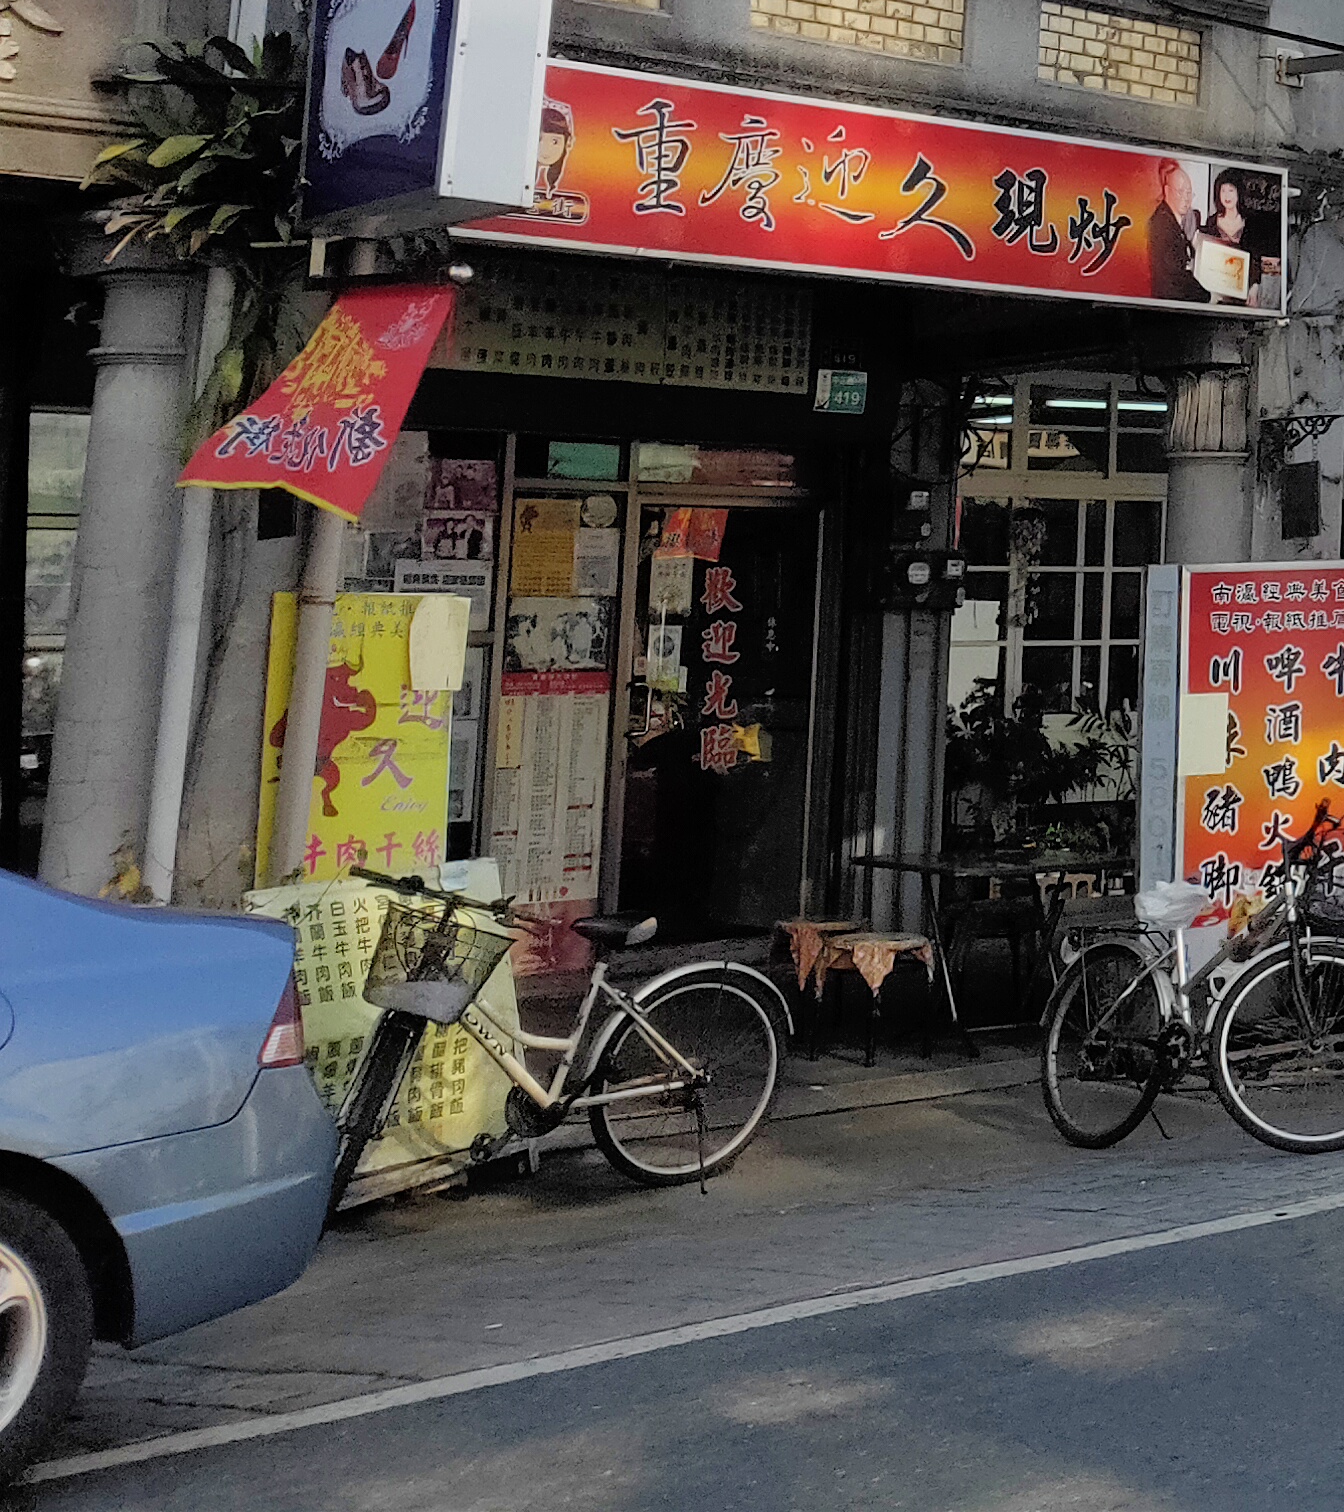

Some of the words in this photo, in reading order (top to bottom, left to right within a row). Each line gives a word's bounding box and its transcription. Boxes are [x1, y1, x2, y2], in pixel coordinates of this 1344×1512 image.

[834, 390, 860, 406] 419
[700, 567, 743, 776] 歡迎光臨
[330, 901, 358, 999] 白玉牛肉飯
